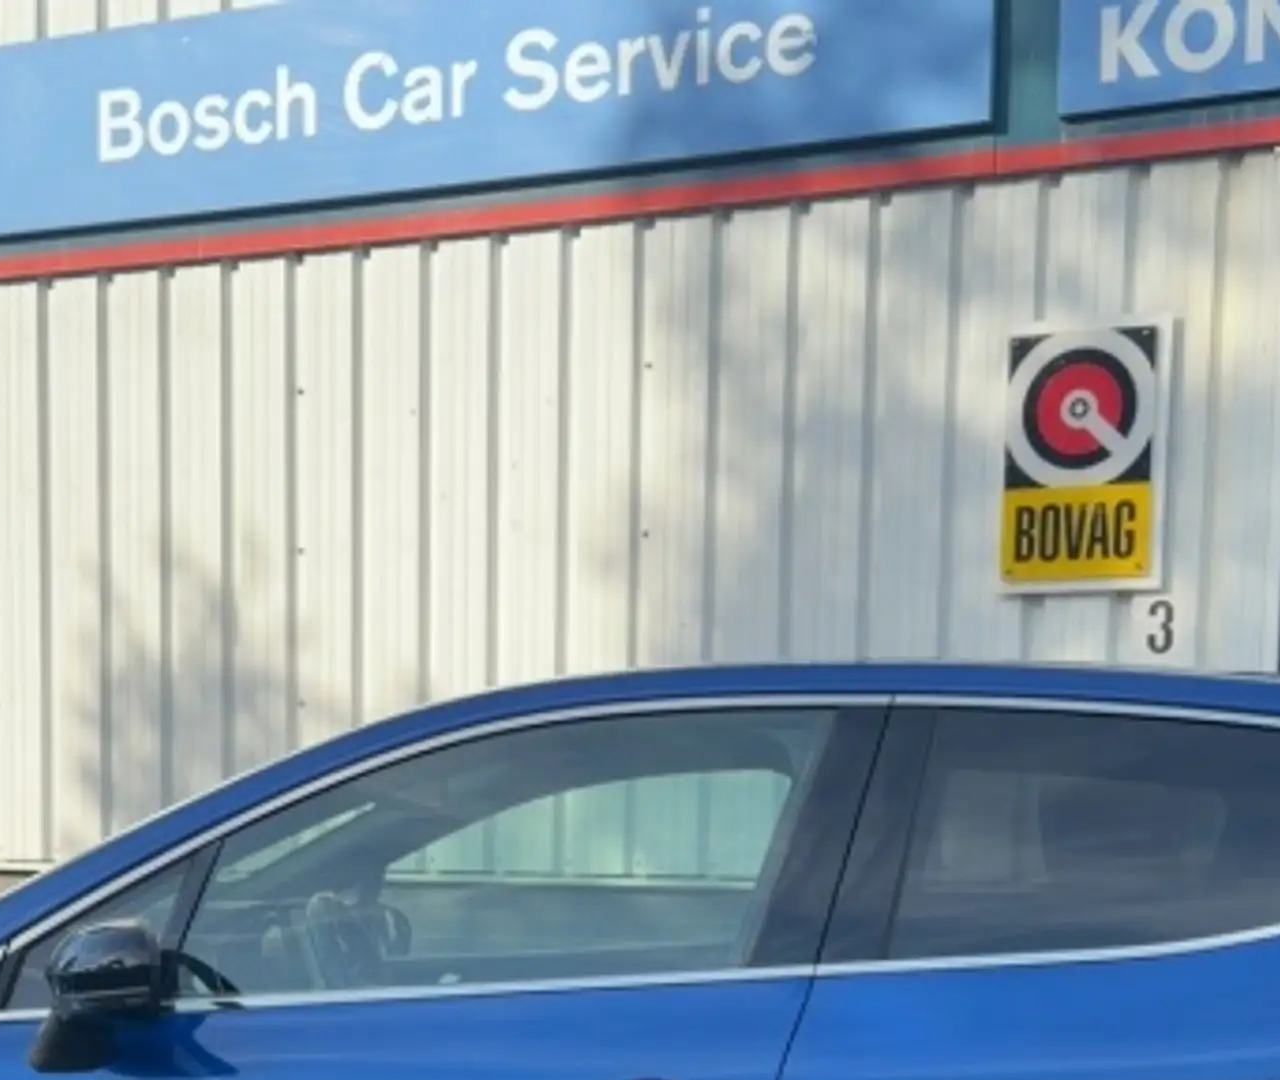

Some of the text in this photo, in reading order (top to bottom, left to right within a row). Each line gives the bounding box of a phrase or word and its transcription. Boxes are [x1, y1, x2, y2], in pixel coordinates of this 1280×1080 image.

[97, 7, 816, 164] Bosch Car Service
[1014, 499, 1136, 563] BOVAG
[1146, 600, 1174, 654] 3
